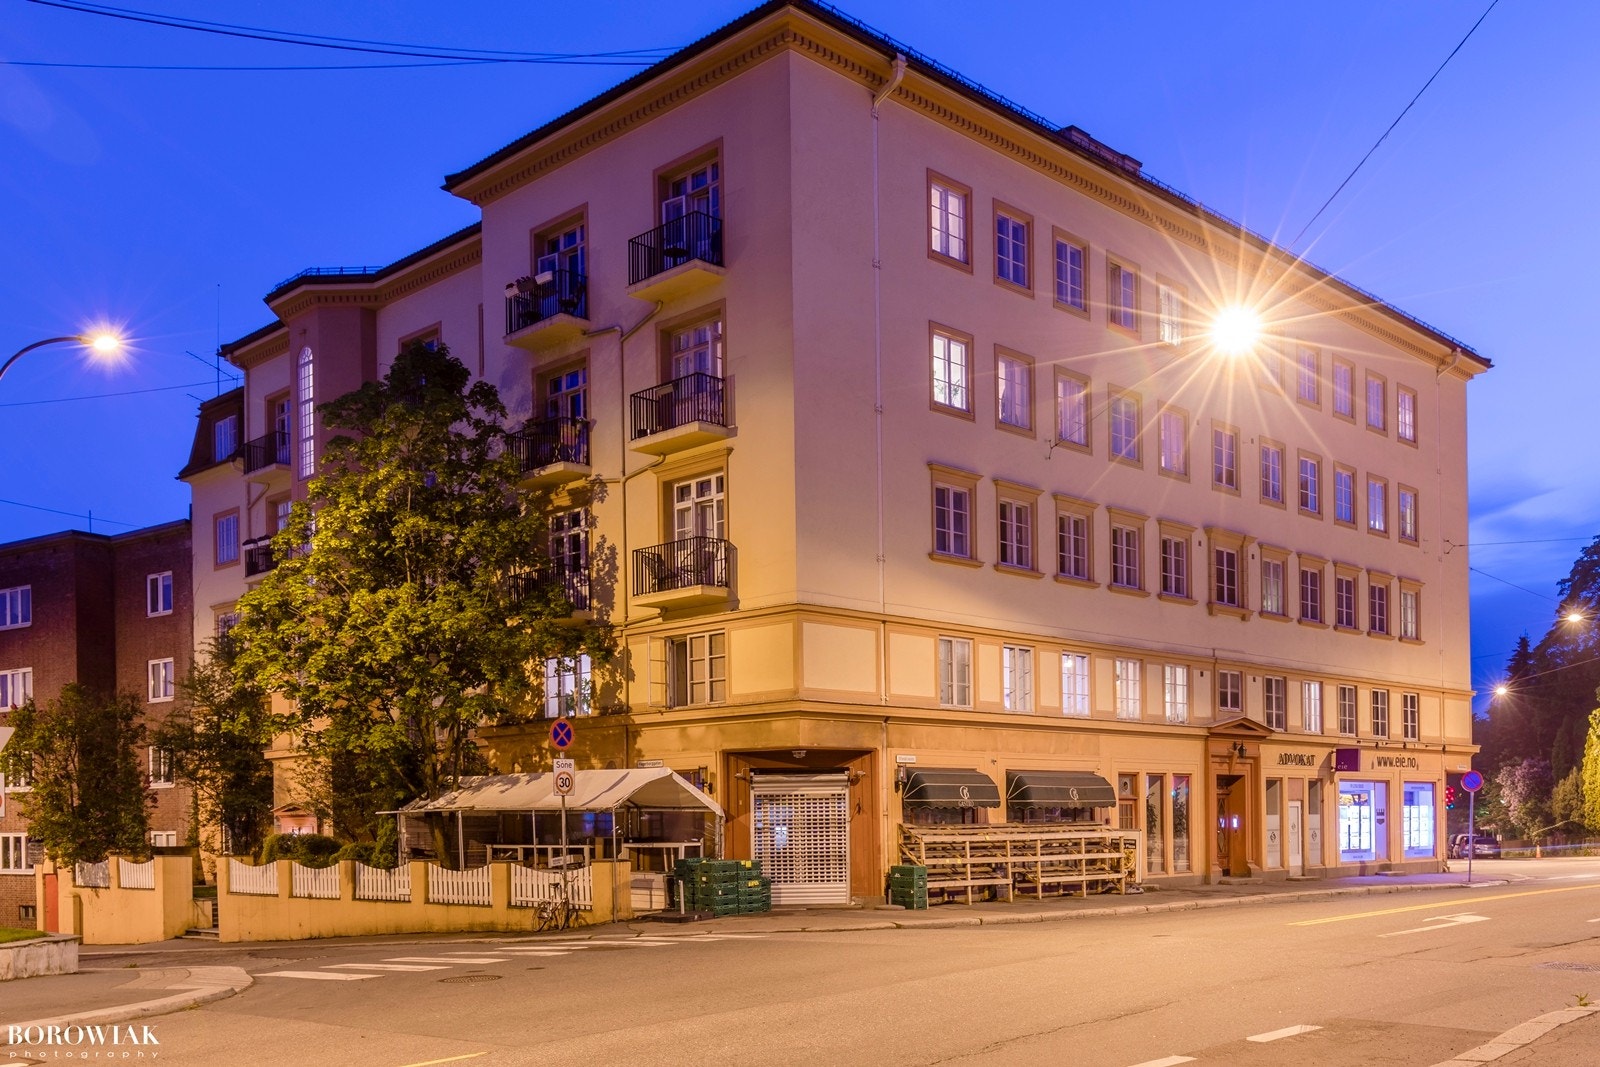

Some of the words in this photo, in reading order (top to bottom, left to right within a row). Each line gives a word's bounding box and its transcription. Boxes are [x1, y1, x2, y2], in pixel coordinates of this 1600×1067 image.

[556, 760, 572, 769] Sone
[1278, 753, 1315, 766] ADVOKAT
[1377, 754, 1416, 768] www.eie.no
[1337, 761, 1348, 770] eie
[559, 777, 570, 788] 30
